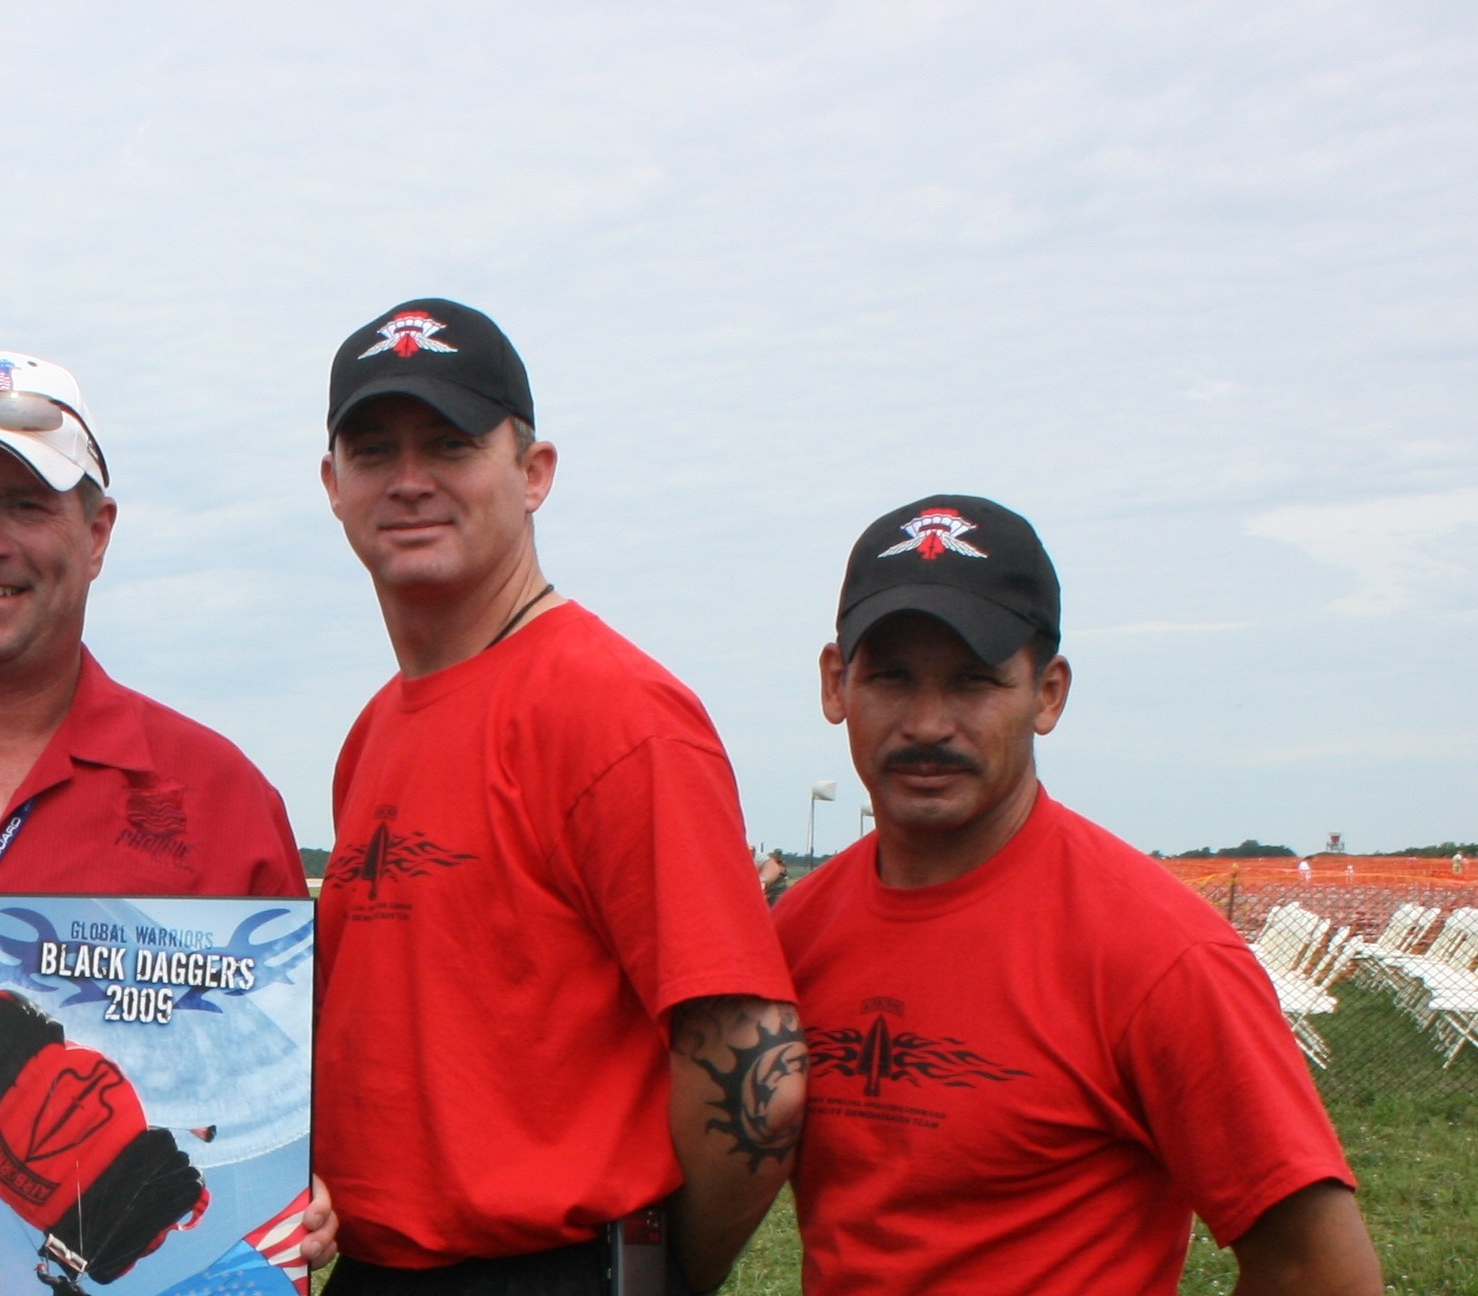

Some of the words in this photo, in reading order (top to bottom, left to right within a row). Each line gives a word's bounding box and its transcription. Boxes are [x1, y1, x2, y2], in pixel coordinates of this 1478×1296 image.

[71, 920, 127, 944] GLOBAL
[135, 926, 214, 949] WARRIORS
[41, 942, 126, 980] BLACK
[136, 949, 255, 990] DAGGERS
[104, 984, 173, 1024] 2009
